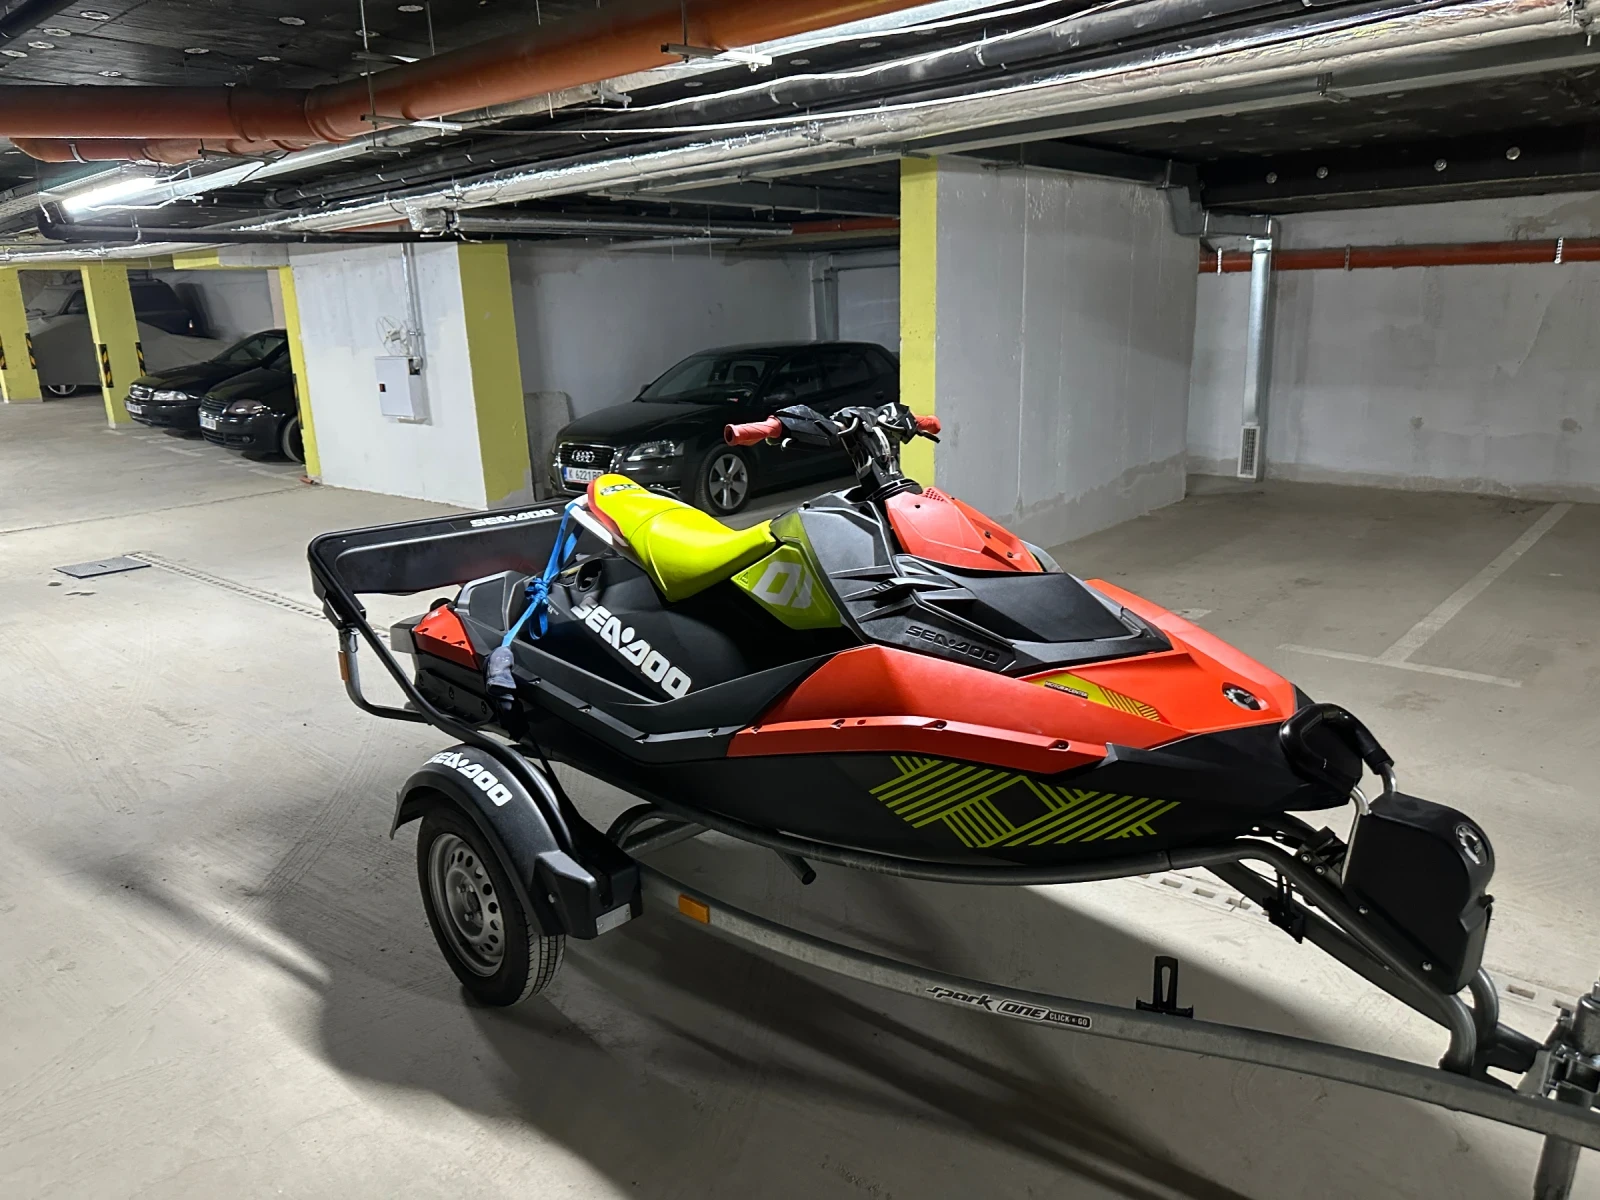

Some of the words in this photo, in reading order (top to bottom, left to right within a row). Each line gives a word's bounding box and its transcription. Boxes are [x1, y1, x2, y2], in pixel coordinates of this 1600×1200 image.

[576, 470, 591, 480] 6221
[1049, 1013, 1070, 1023] CLICK
[1077, 1018, 1088, 1026] GO
